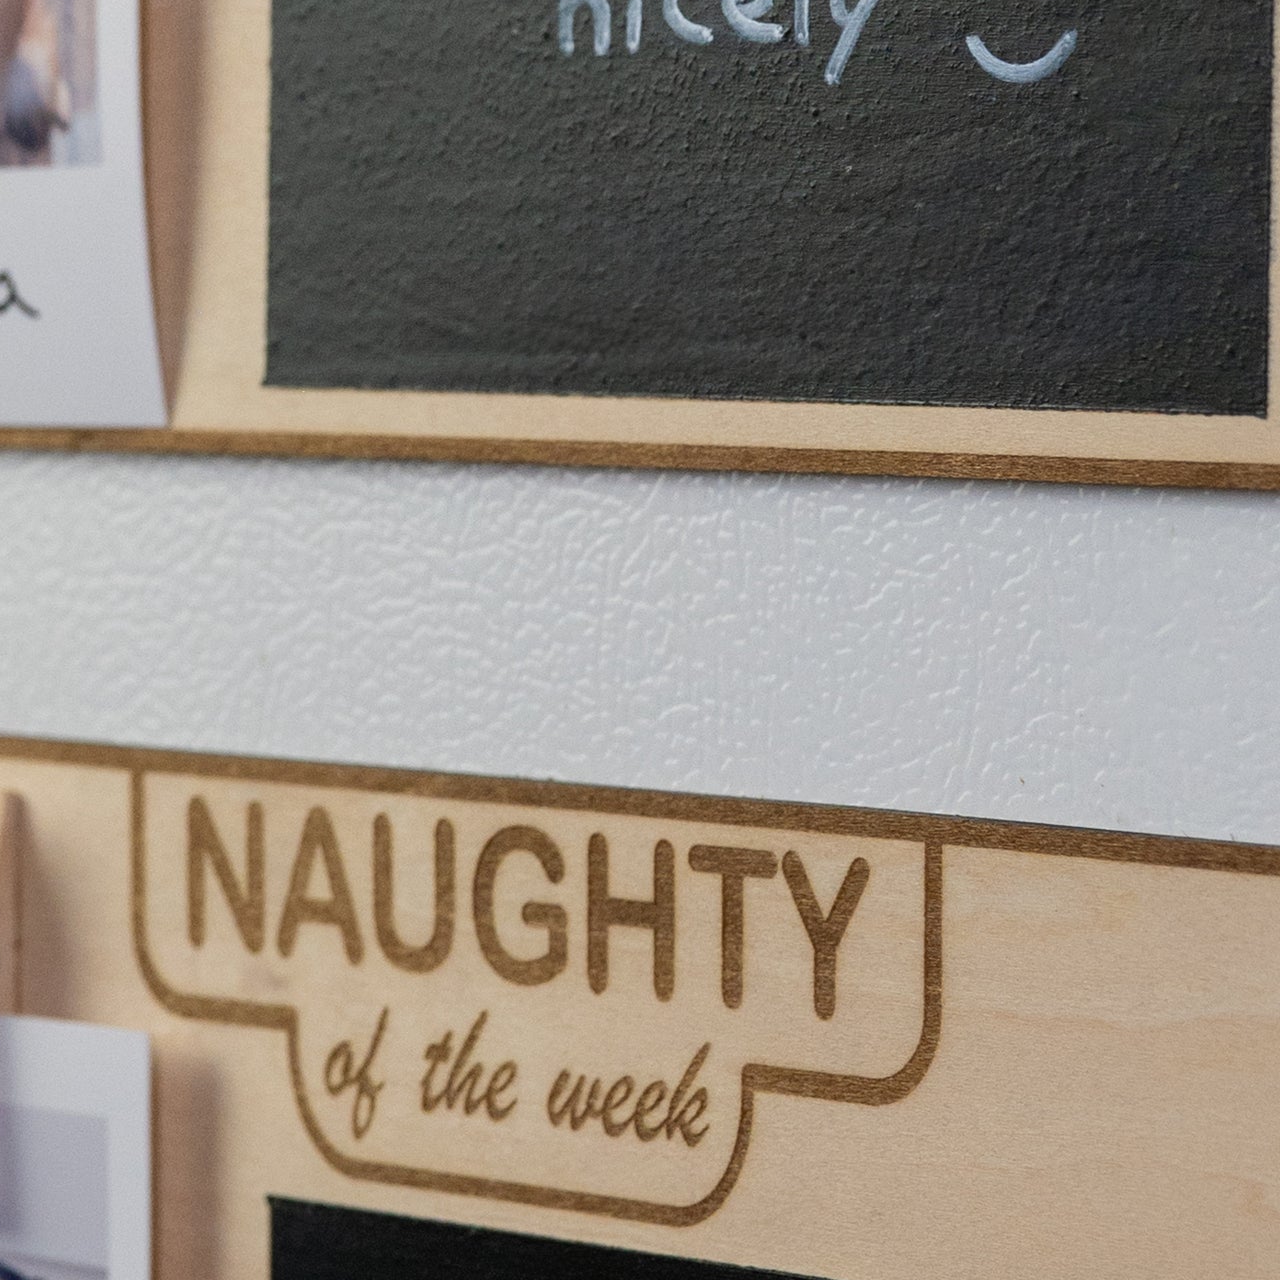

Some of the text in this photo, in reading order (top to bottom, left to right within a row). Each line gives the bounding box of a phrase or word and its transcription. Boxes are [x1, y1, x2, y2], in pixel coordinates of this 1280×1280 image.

[186, 797, 871, 1021] NAUGHTY
[325, 1008, 711, 1150] of the week
